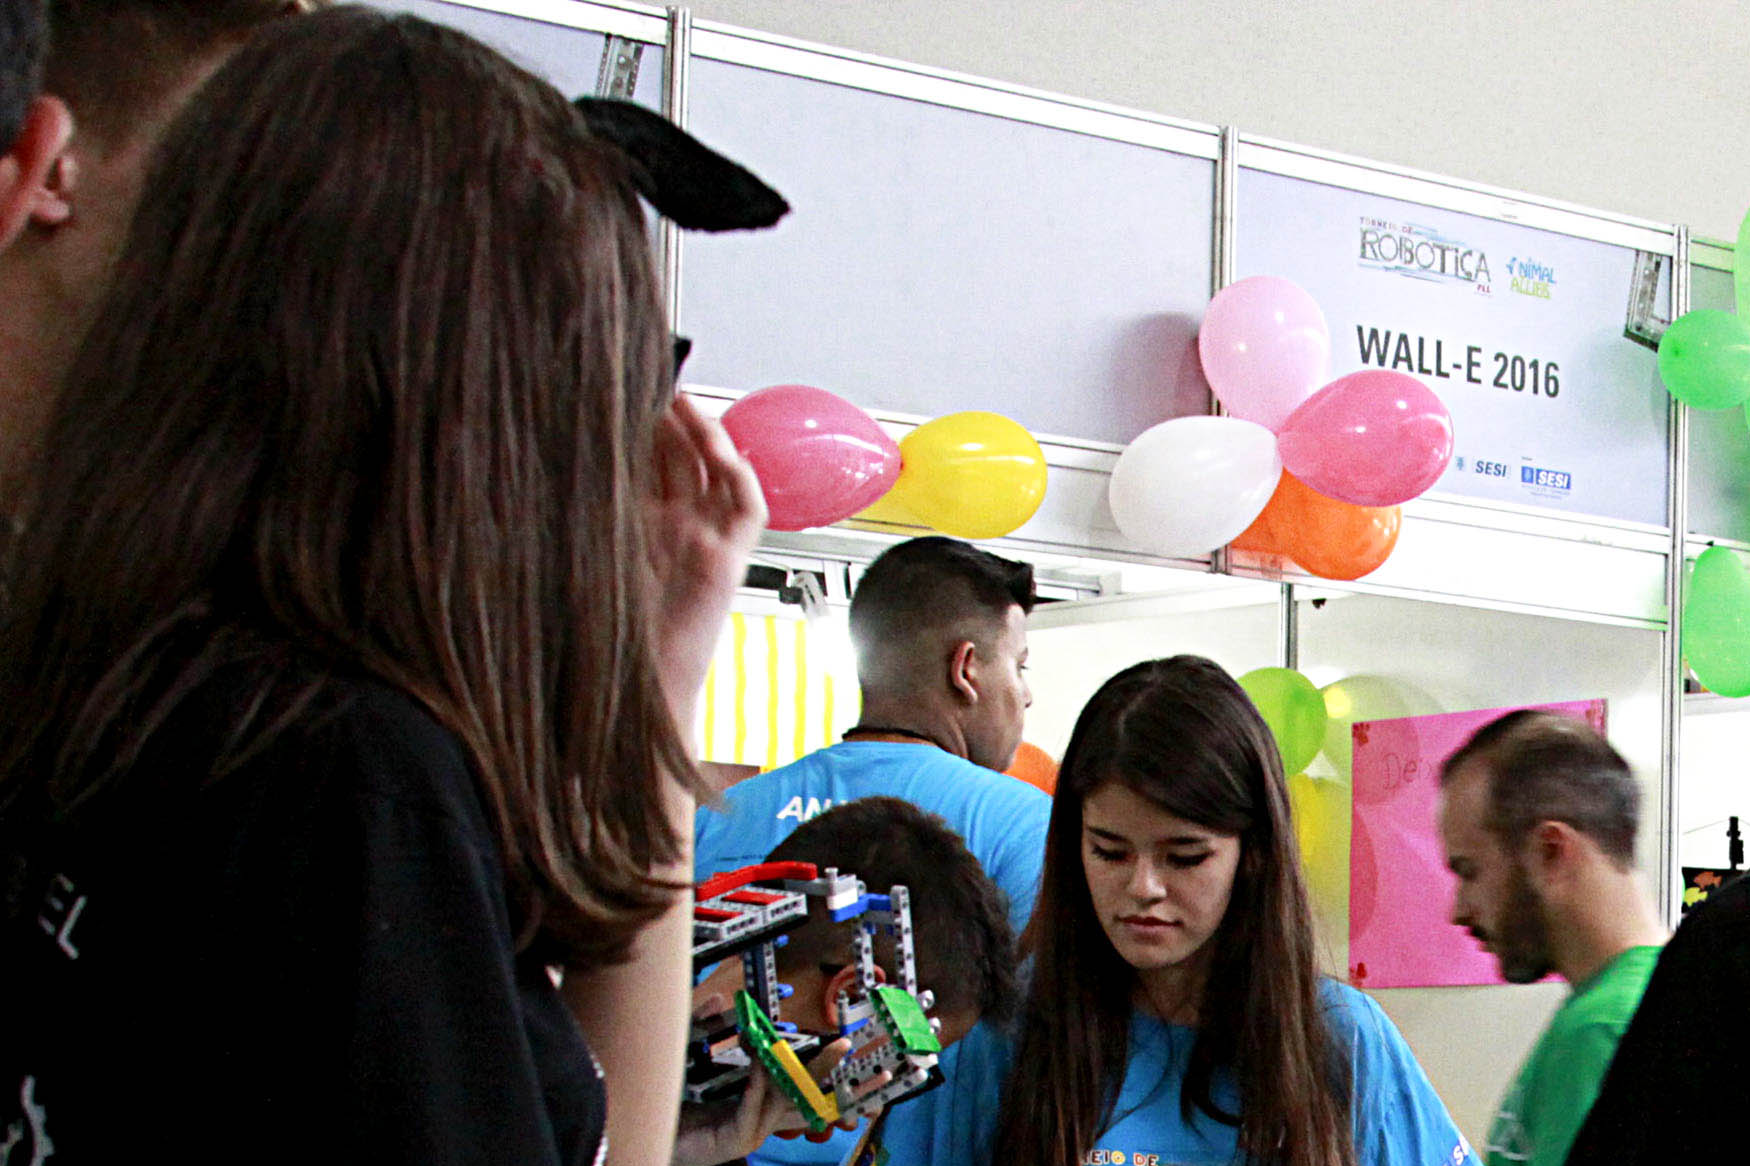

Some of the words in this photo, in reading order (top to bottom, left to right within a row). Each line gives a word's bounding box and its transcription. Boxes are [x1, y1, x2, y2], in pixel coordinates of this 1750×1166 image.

[1356, 324, 1482, 384] WALL-E
[1492, 352, 1560, 398] 2016
[1475, 459, 1507, 478] SESI
[1537, 470, 1570, 489] SESI
